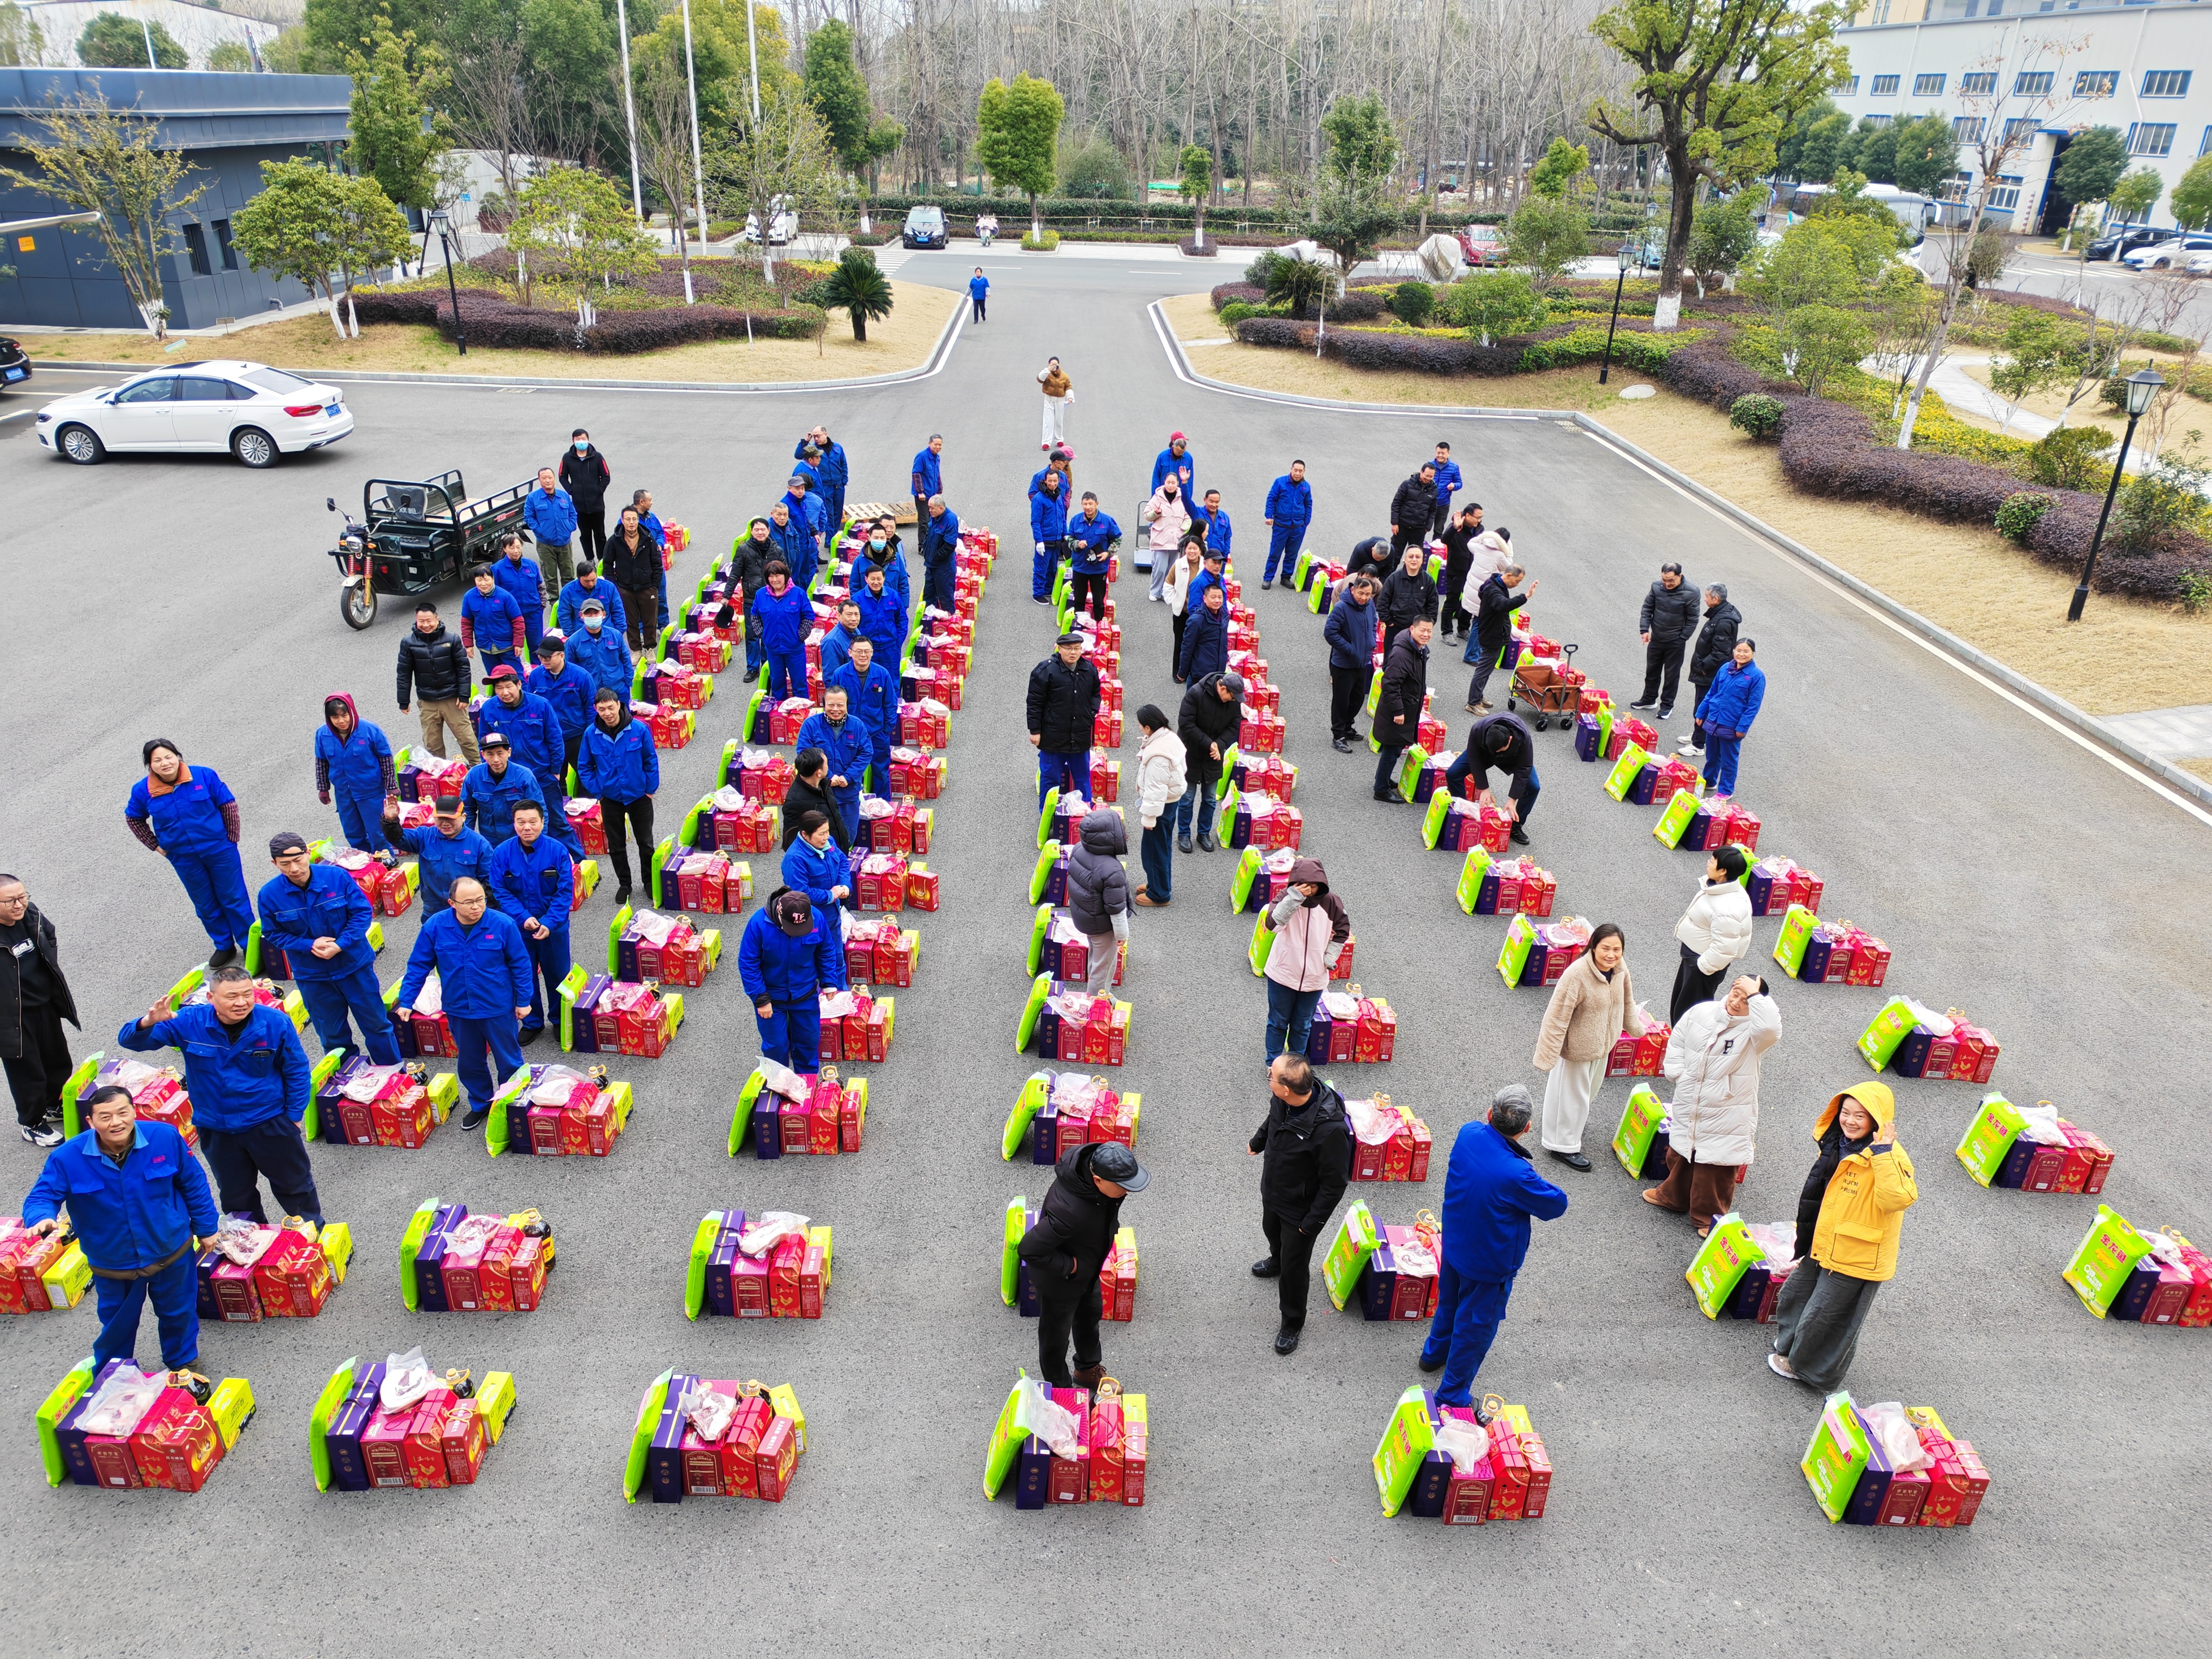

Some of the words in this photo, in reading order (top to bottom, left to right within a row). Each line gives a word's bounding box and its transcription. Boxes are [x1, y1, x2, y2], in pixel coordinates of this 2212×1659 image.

[1790, 917, 1803, 934] 金龙鱼
[1723, 1040, 1734, 1054] P
[1633, 1103, 1649, 1128] 金龙鱼
[1986, 1112, 2008, 1137] 金龙鱼
[1719, 1236, 1739, 1267] 金龙鱼
[2100, 1233, 2127, 1264] 金龙鱼
[1398, 1418, 1412, 1457] 金龙鱼
